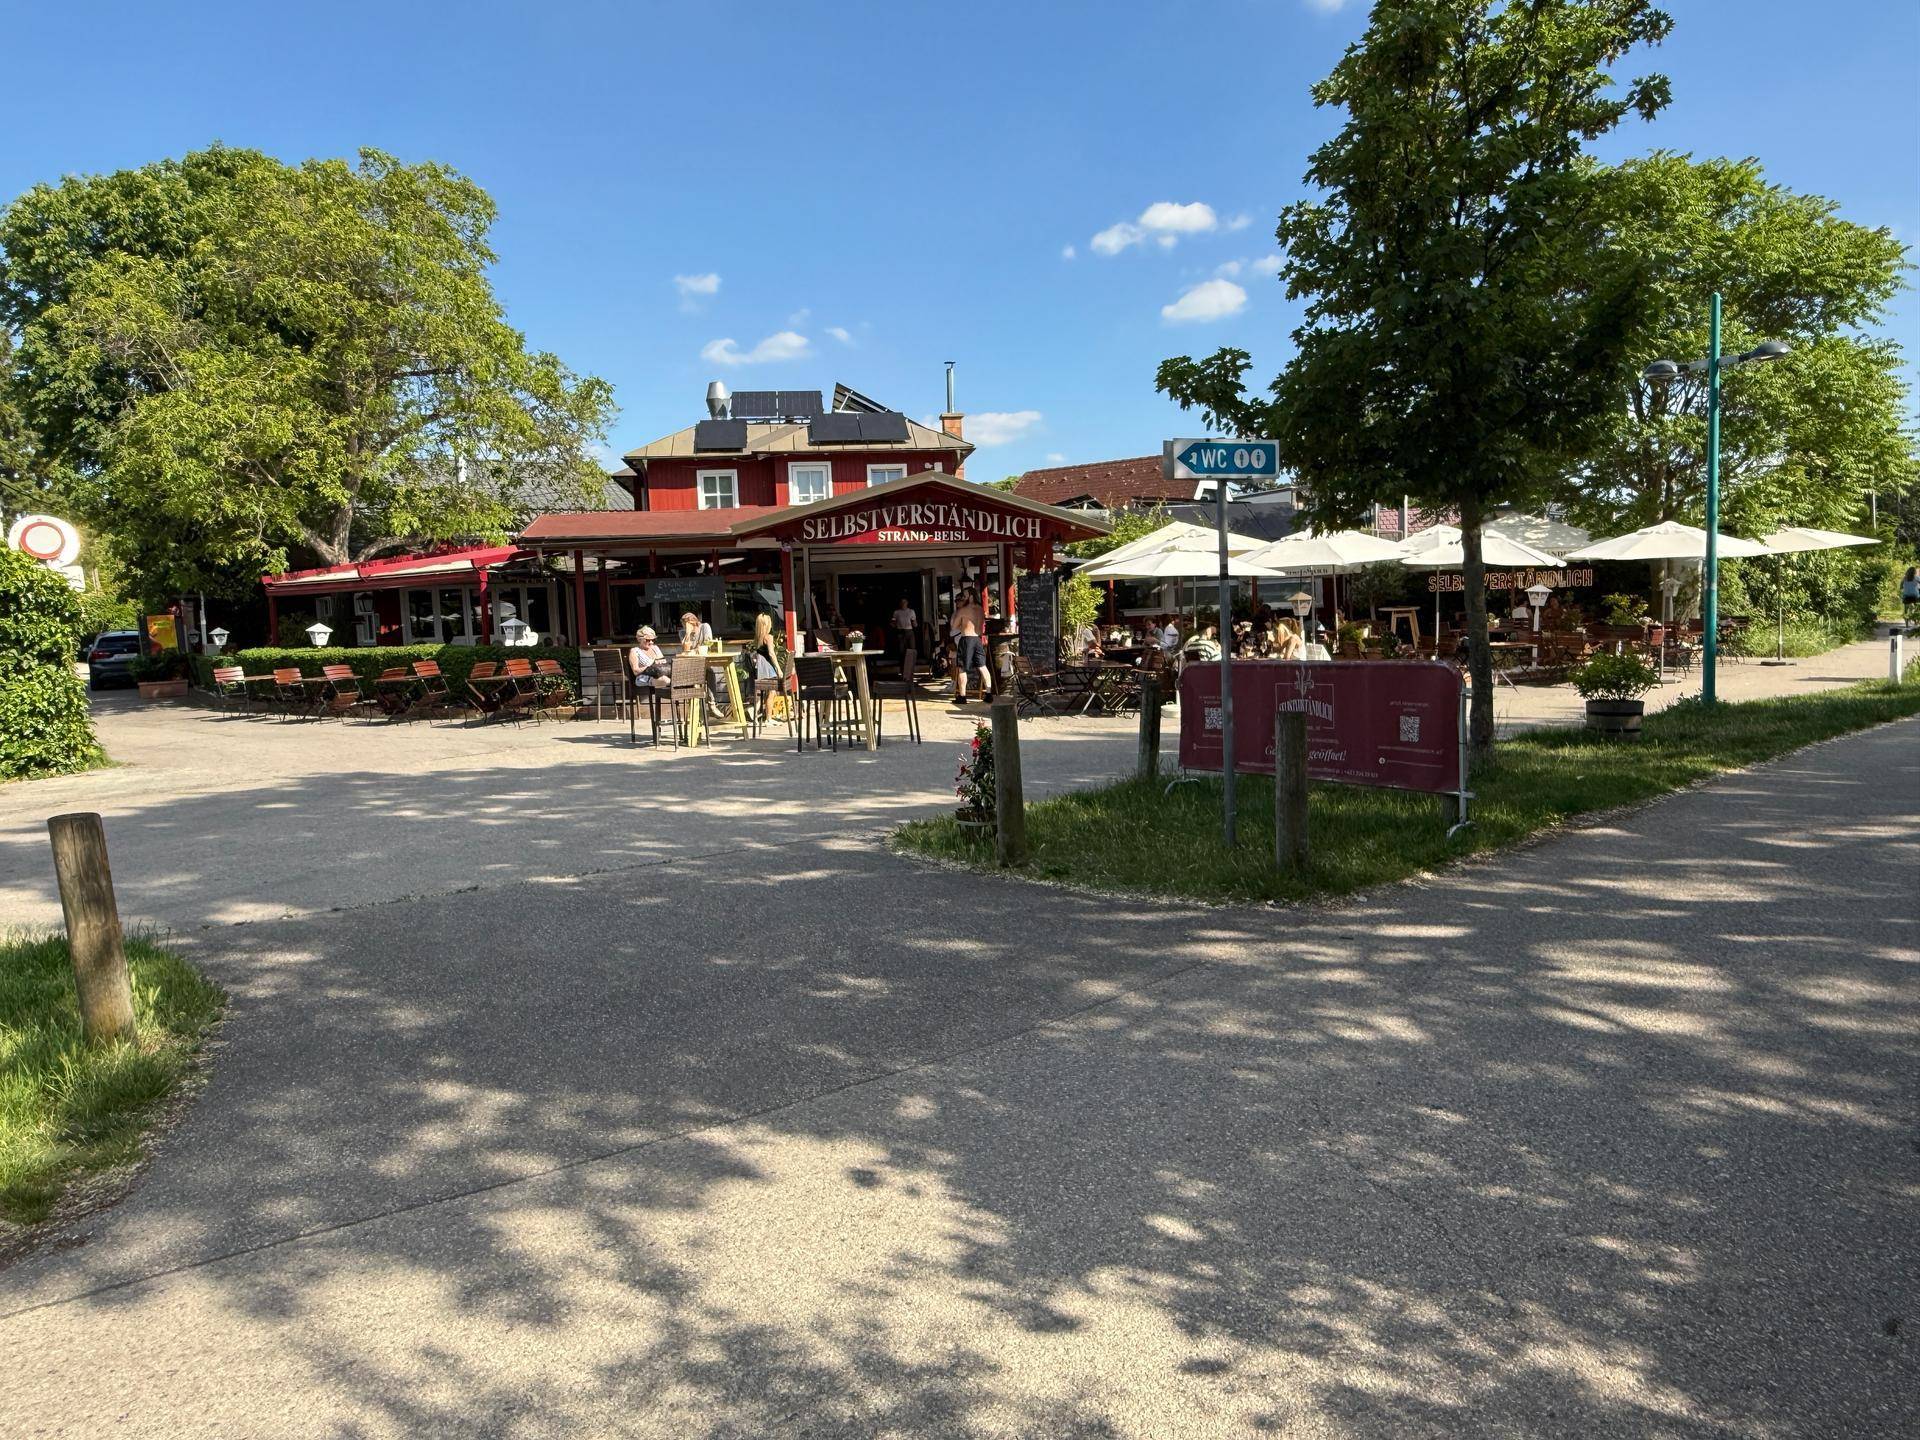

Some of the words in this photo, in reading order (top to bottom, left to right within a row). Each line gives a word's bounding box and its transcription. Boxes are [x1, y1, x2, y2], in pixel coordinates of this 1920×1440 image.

[1201, 448, 1227, 469] WC
[803, 503, 1042, 540] SELBSTVERSTÄNDLICH
[878, 530, 970, 542] STRAND-BEISL
